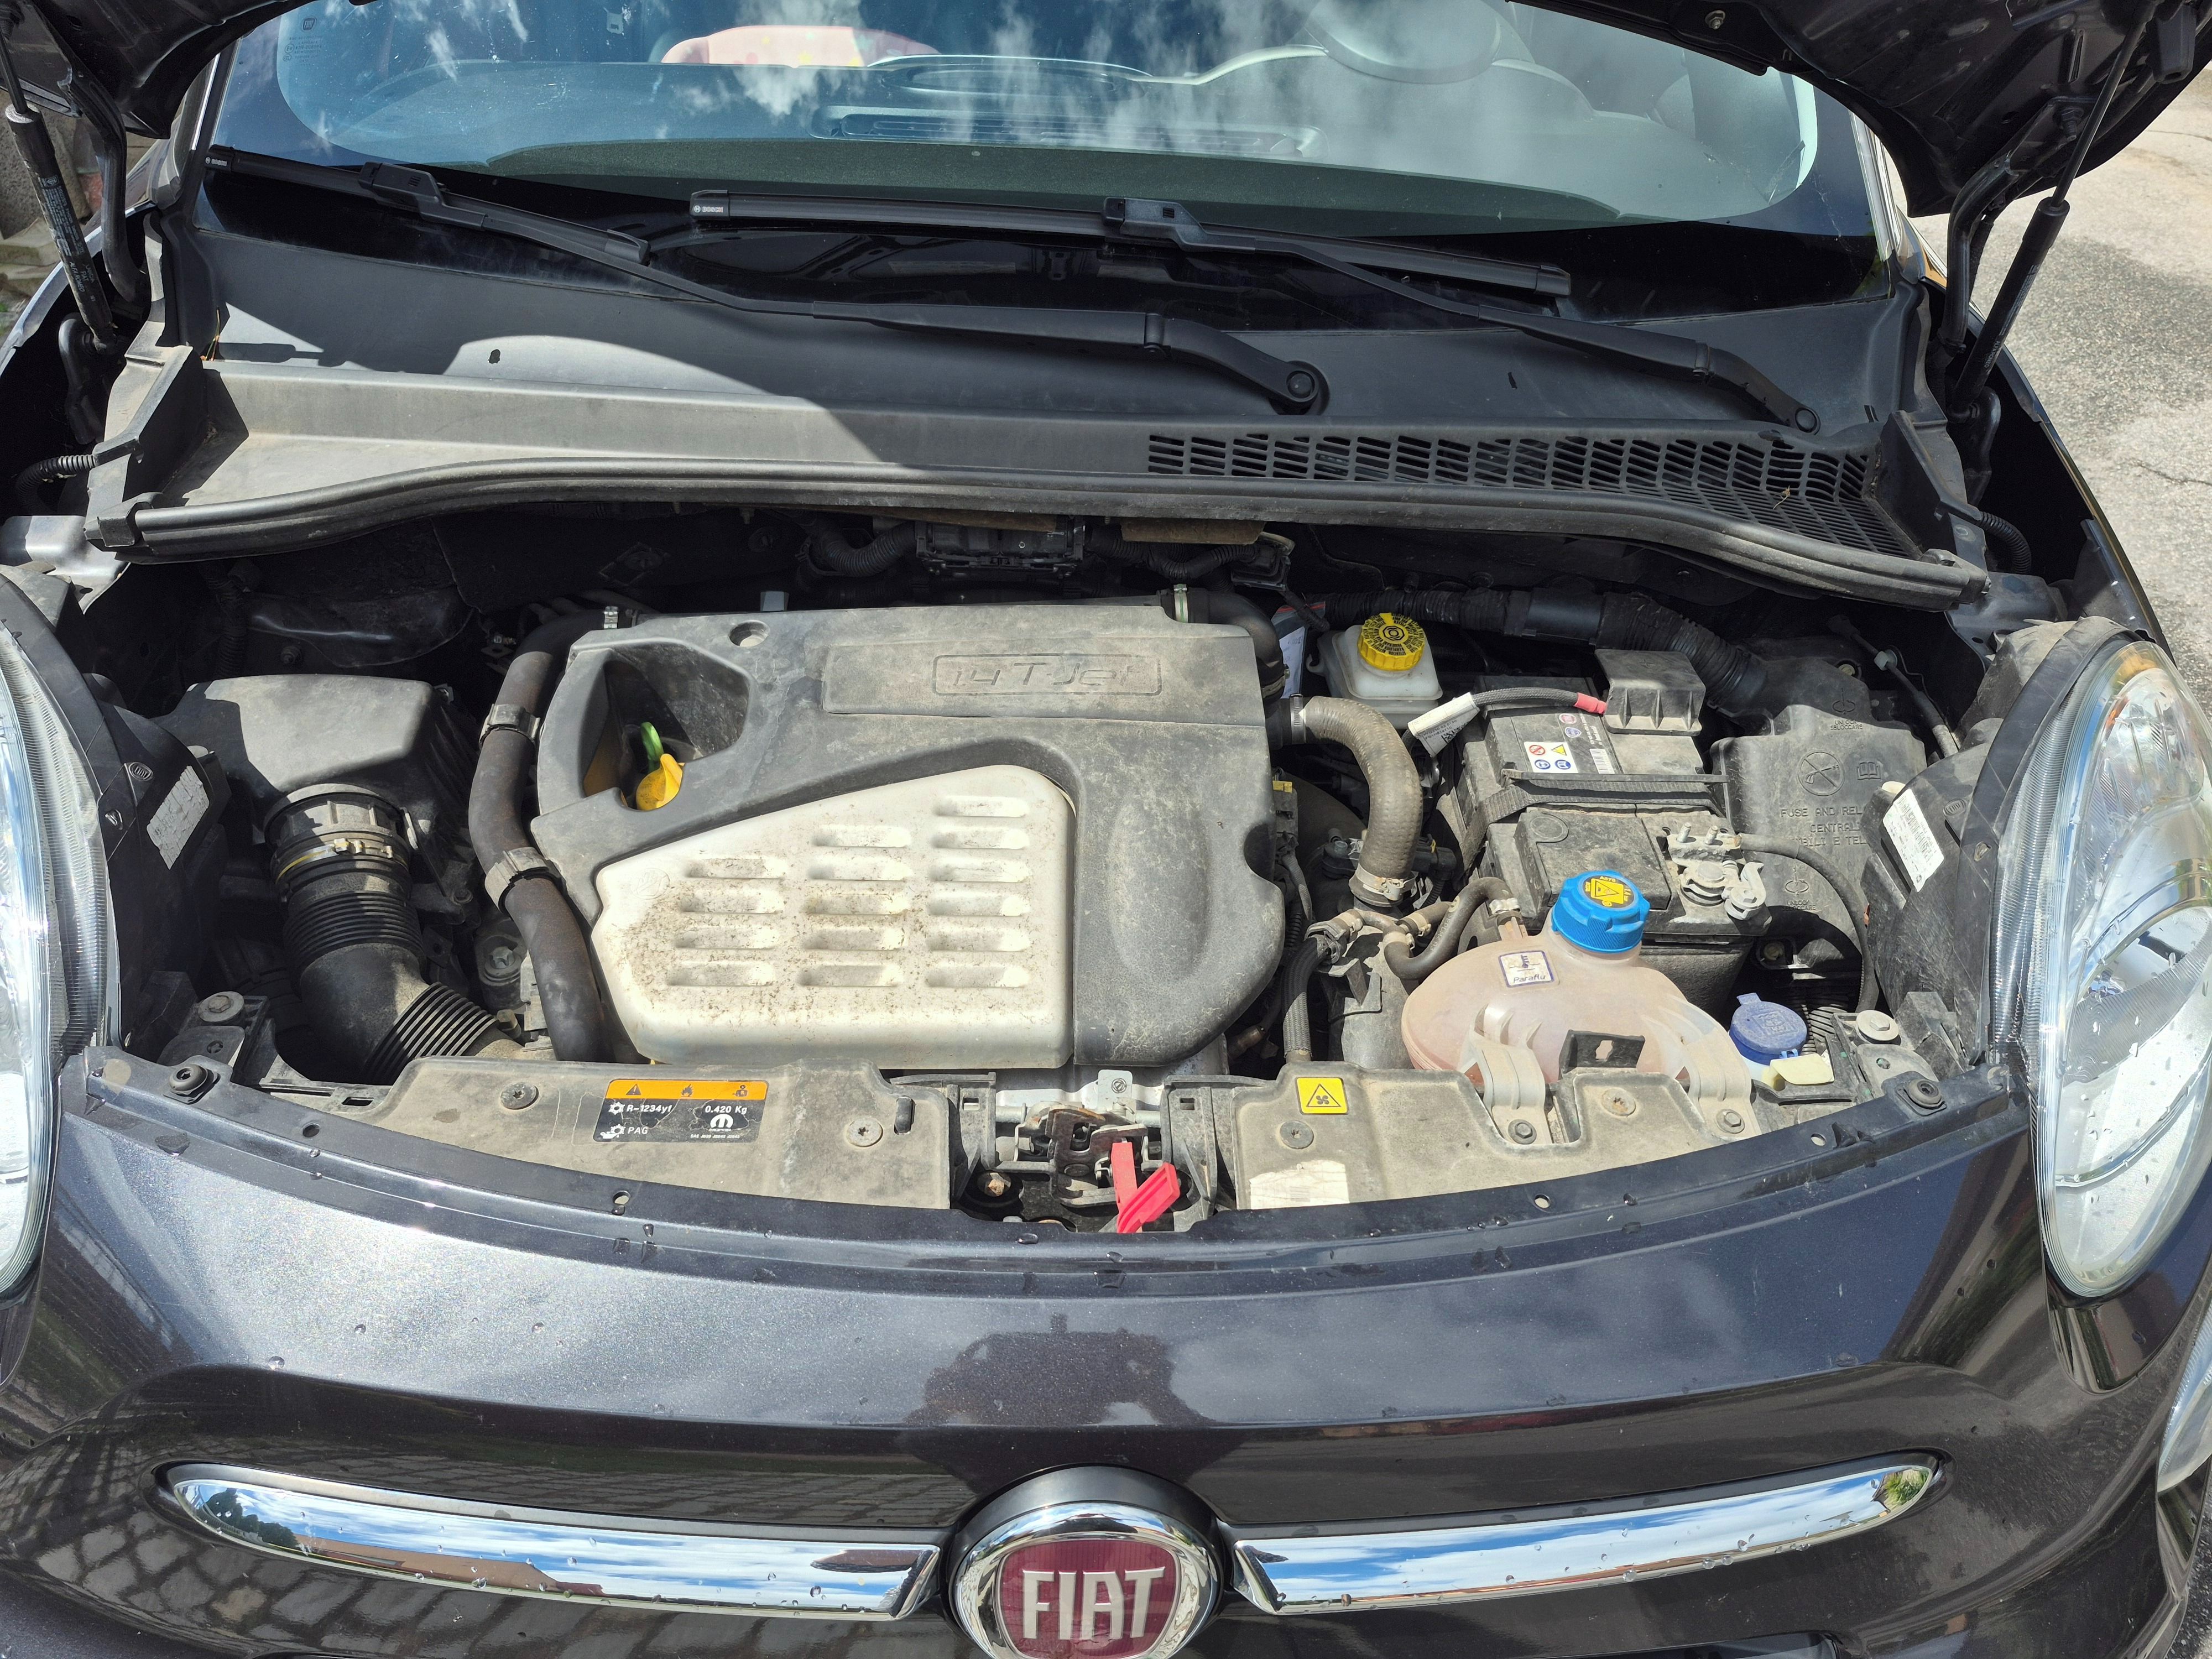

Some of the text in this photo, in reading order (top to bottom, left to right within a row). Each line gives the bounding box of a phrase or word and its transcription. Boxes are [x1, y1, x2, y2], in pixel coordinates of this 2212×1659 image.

[80, 270, 90, 281] FIAT
[1780, 808, 1808, 817] FUSE
[1815, 807, 1835, 816] AND
[1833, 836, 1840, 845] E
[1514, 974, 1546, 983] Paraflu
[627, 1104, 748, 1115] R-1234yf 0.420 Kg
[628, 1126, 648, 1135] PAG
[1022, 1567, 1165, 1640] FIAT
